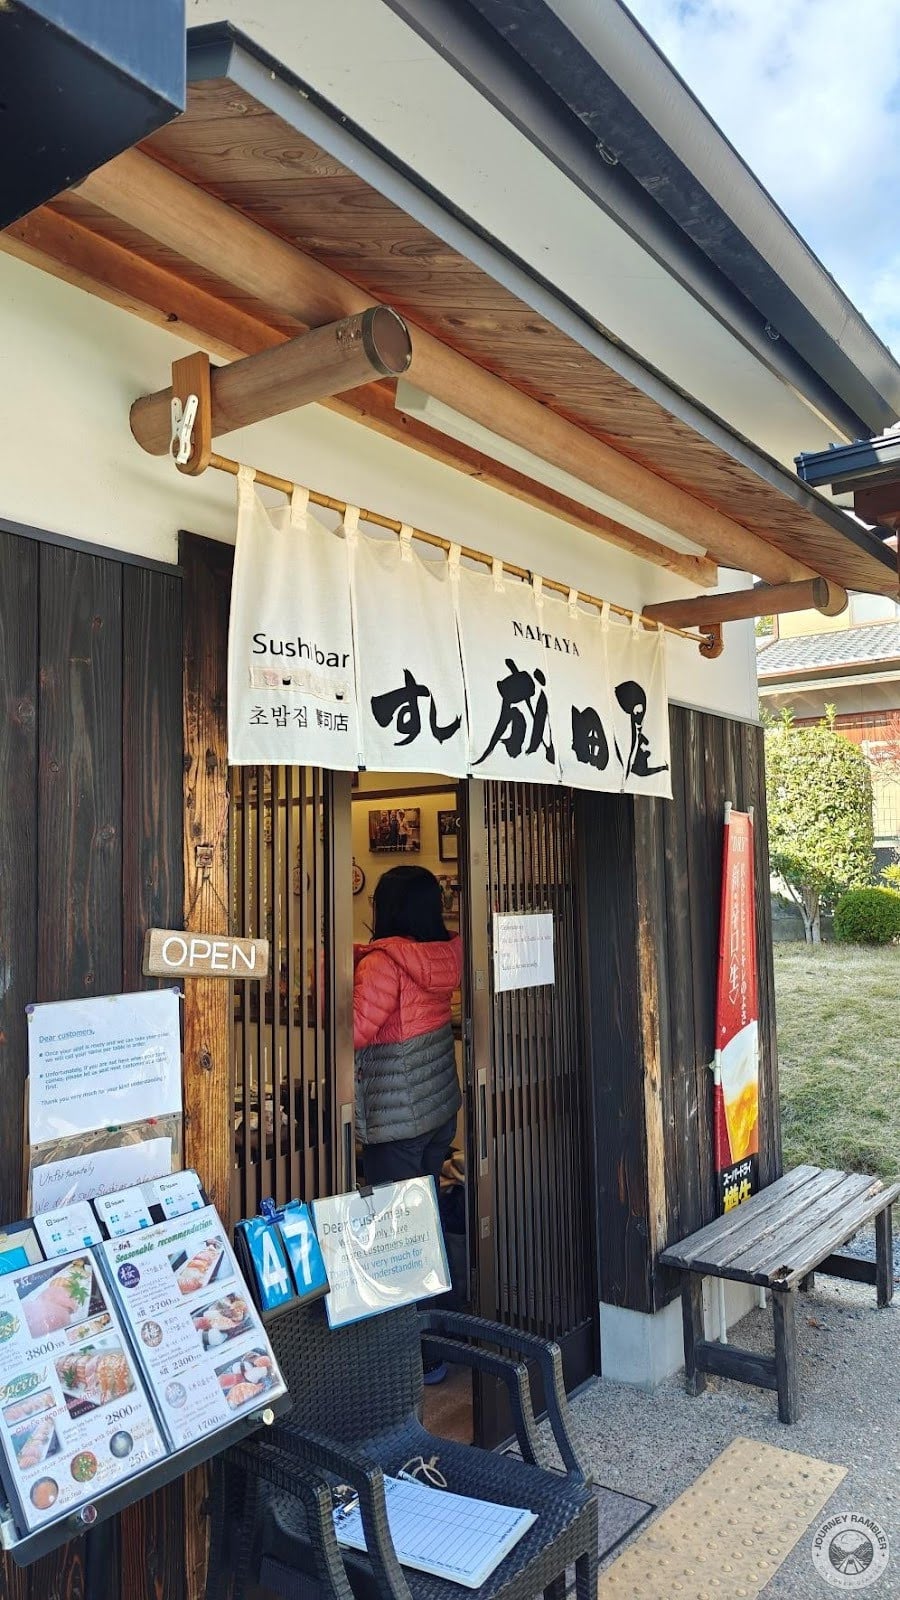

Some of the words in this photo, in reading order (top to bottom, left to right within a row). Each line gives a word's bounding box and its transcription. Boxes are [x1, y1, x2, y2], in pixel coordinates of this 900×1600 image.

[252, 633, 313, 660] Sushi
[314, 643, 350, 668] bar
[249, 704, 308, 728] 초밥집
[371, 668, 462, 746] すし
[469, 657, 669, 780] 成田屋
[162, 937, 257, 970] OPEN
[38, 1035, 56, 1044] Dear
[52, 1215, 69, 1225] Square
[322, 1221, 348, 1236] Dear
[115, 1242, 155, 1264] Seasonable
[157, 1219, 213, 1248] recommendation
[371, 1257, 389, 1269] very
[390, 1252, 411, 1264] much
[412, 1247, 423, 1257] for
[148, 1298, 172, 1314] 2700
[25, 1340, 55, 1362] 3800
[171, 1354, 195, 1371] 2300
[105, 1404, 133, 1426] 2800
[198, 1415, 219, 1431] 1700
